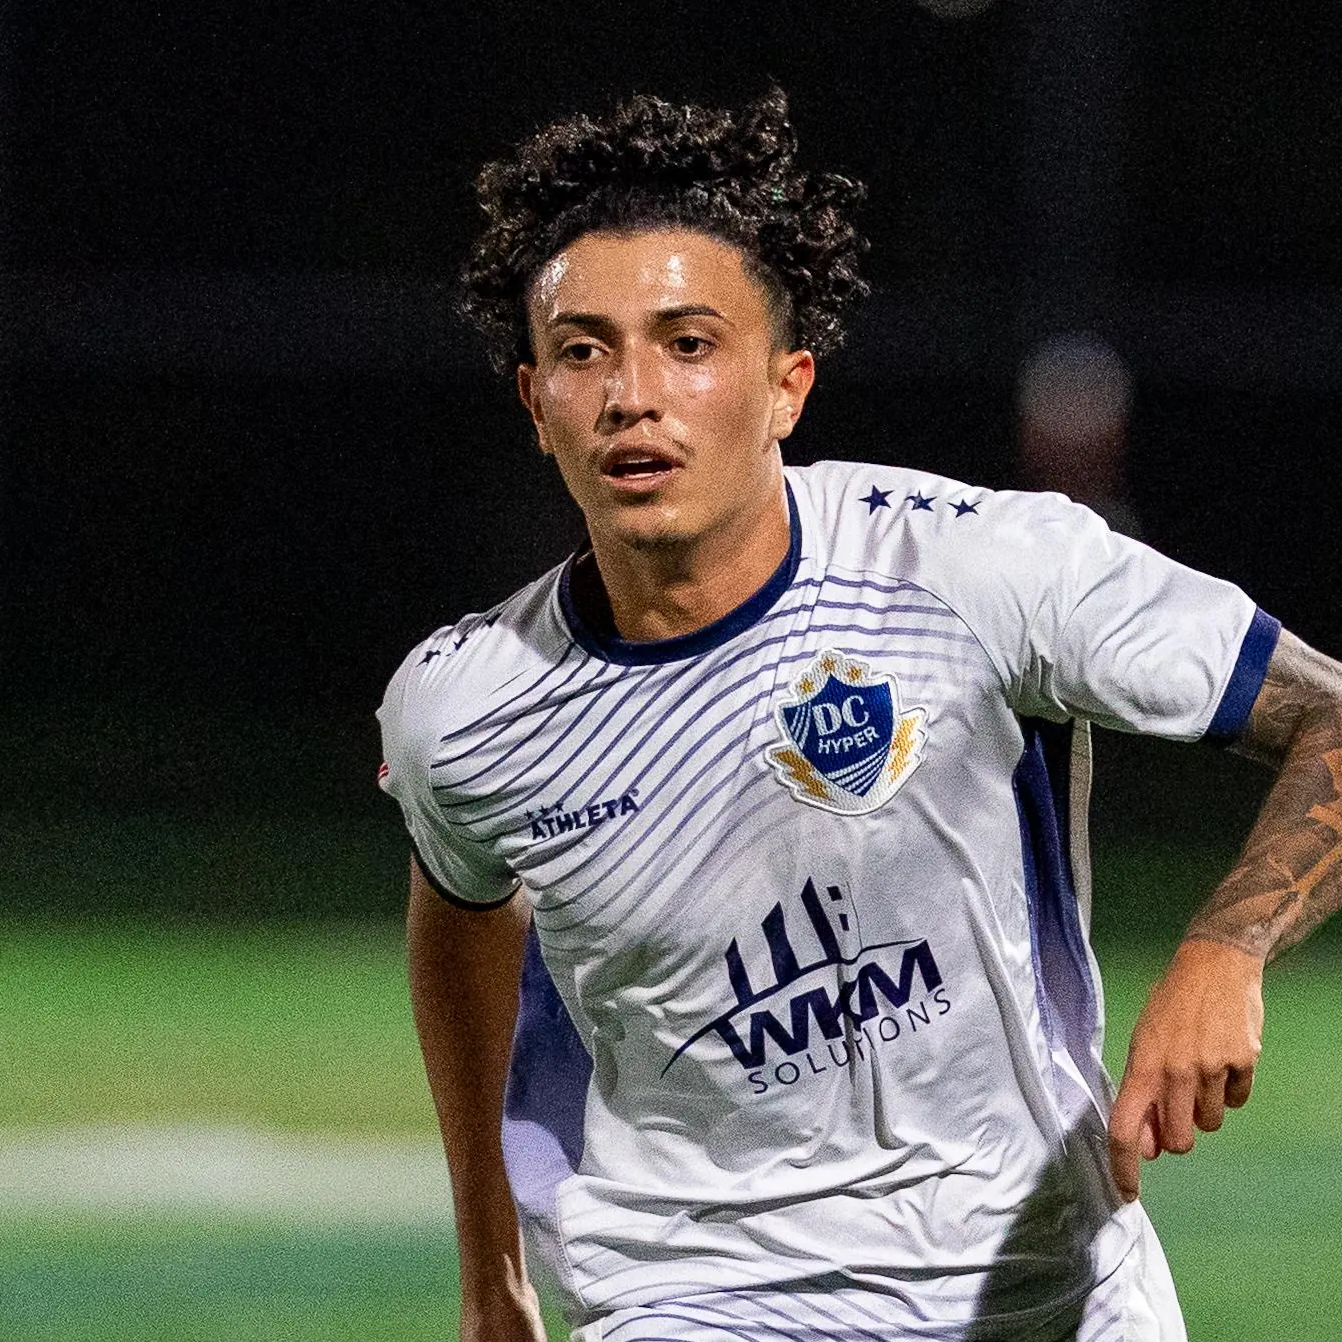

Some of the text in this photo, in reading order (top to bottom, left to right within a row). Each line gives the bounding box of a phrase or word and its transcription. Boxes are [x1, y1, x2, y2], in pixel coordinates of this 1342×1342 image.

[812, 695, 870, 736] DC
[818, 726, 880, 754] HYPER
[531, 794, 639, 840] ATHLETA
[711, 939, 943, 1069] WKM
[748, 988, 951, 1094] SOLUTIONS
